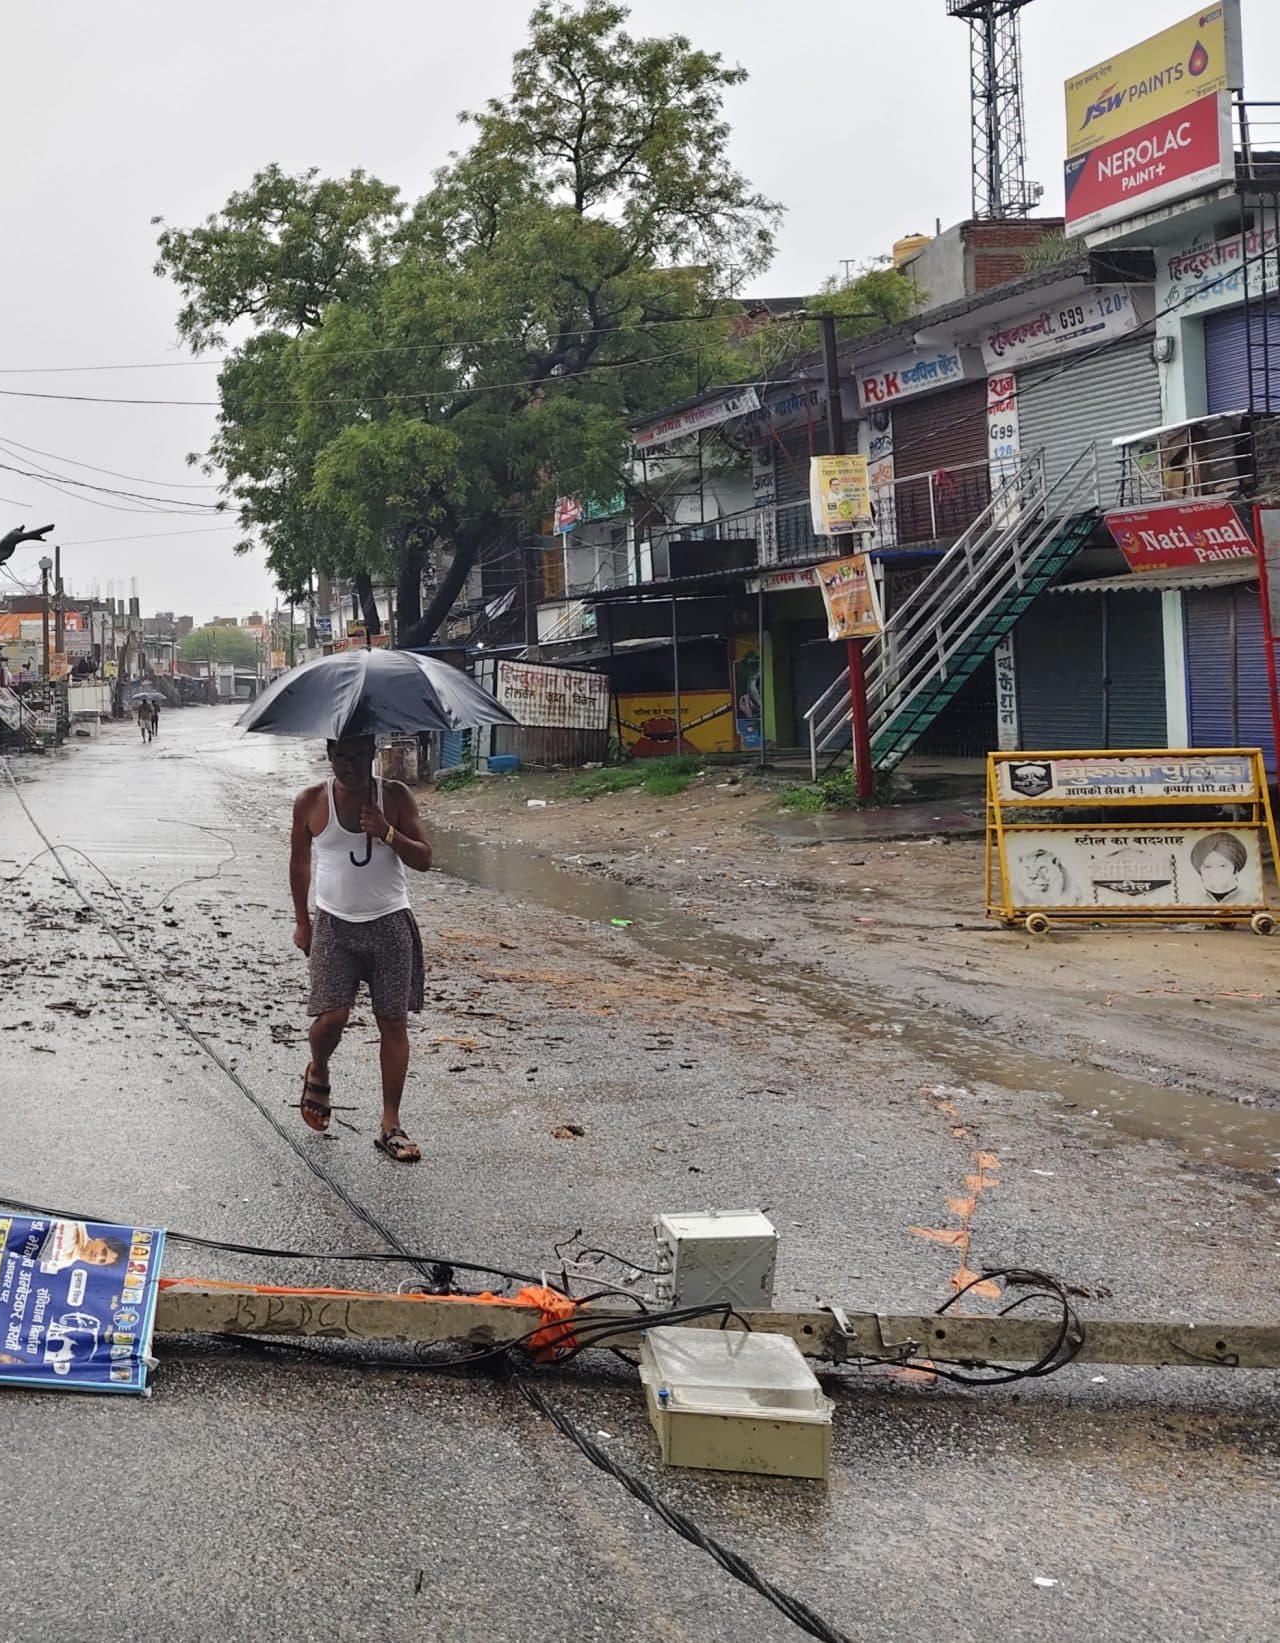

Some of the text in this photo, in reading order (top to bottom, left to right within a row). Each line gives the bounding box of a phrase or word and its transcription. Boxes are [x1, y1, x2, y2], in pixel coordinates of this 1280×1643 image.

[1079, 63, 1183, 131] JSW PAINTS
[1098, 122, 1192, 182] NEROLAC
[1121, 163, 1166, 191] PAINT+
[1168, 240, 1240, 281] हिन्दुस्तान
[1059, 306, 1083, 330] G99
[989, 376, 1014, 397] राज
[1195, 545, 1252, 563] Paints
[1162, 757, 1246, 785] पुलिस
[1065, 785, 1101, 796] आपकी
[1104, 784, 1124, 795] सेवा
[1074, 833, 1185, 846] स्टील का बादशाह
[3, 1258, 15, 1288] अवसर
[0, 1289, 9, 1303] पर
[11, 1269, 32, 1320] अम्बेडकर
[32, 1287, 50, 1322] संविधान
[5, 1322, 24, 1351] जयंती
